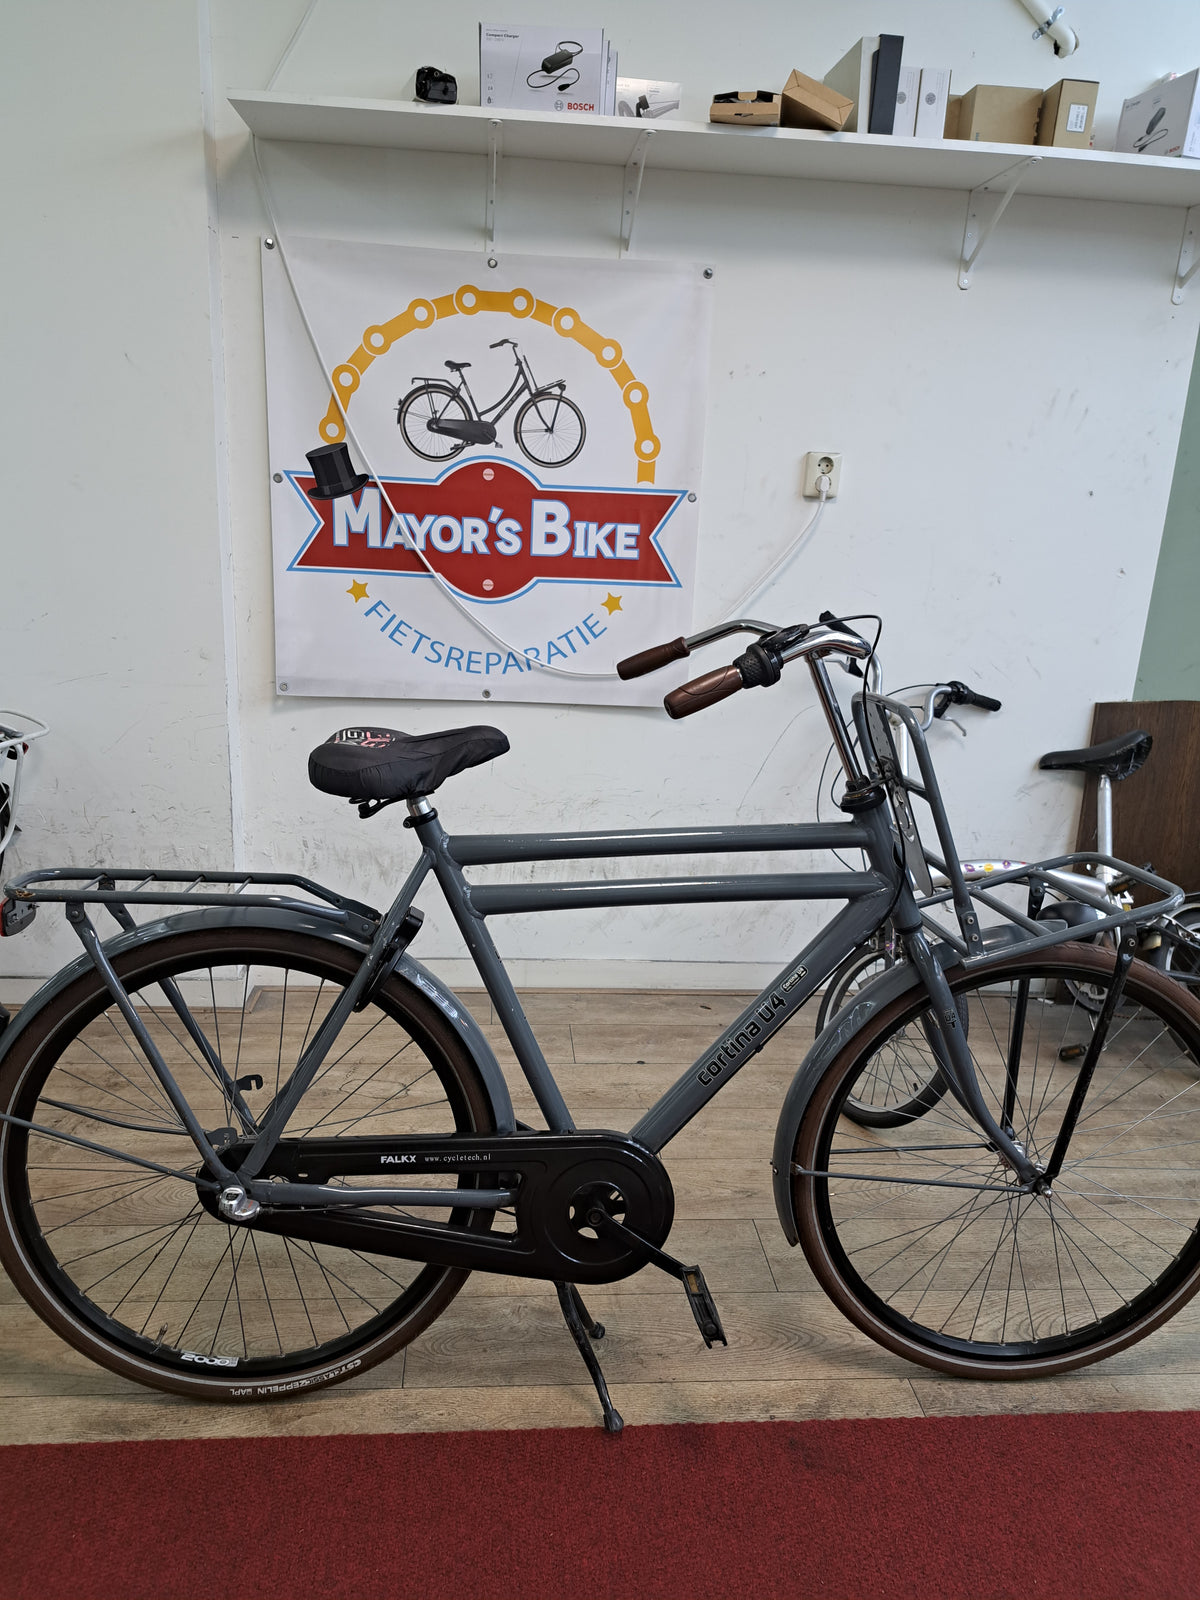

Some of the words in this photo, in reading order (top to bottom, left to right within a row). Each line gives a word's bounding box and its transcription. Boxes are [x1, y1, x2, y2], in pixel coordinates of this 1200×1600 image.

[567, 102, 595, 111] BOSCH
[530, 498, 641, 560] BIKE
[363, 599, 608, 675] FIETSREPARATIE
[696, 1020, 761, 1087] cortina
[755, 991, 787, 1023] U4
[380, 1155, 417, 1164] FALKX
[424, 1153, 491, 1163] www.cycletech.nl
[340, 1358, 362, 1373] CST
[257, 1379, 309, 1395] ZEPPELIN
